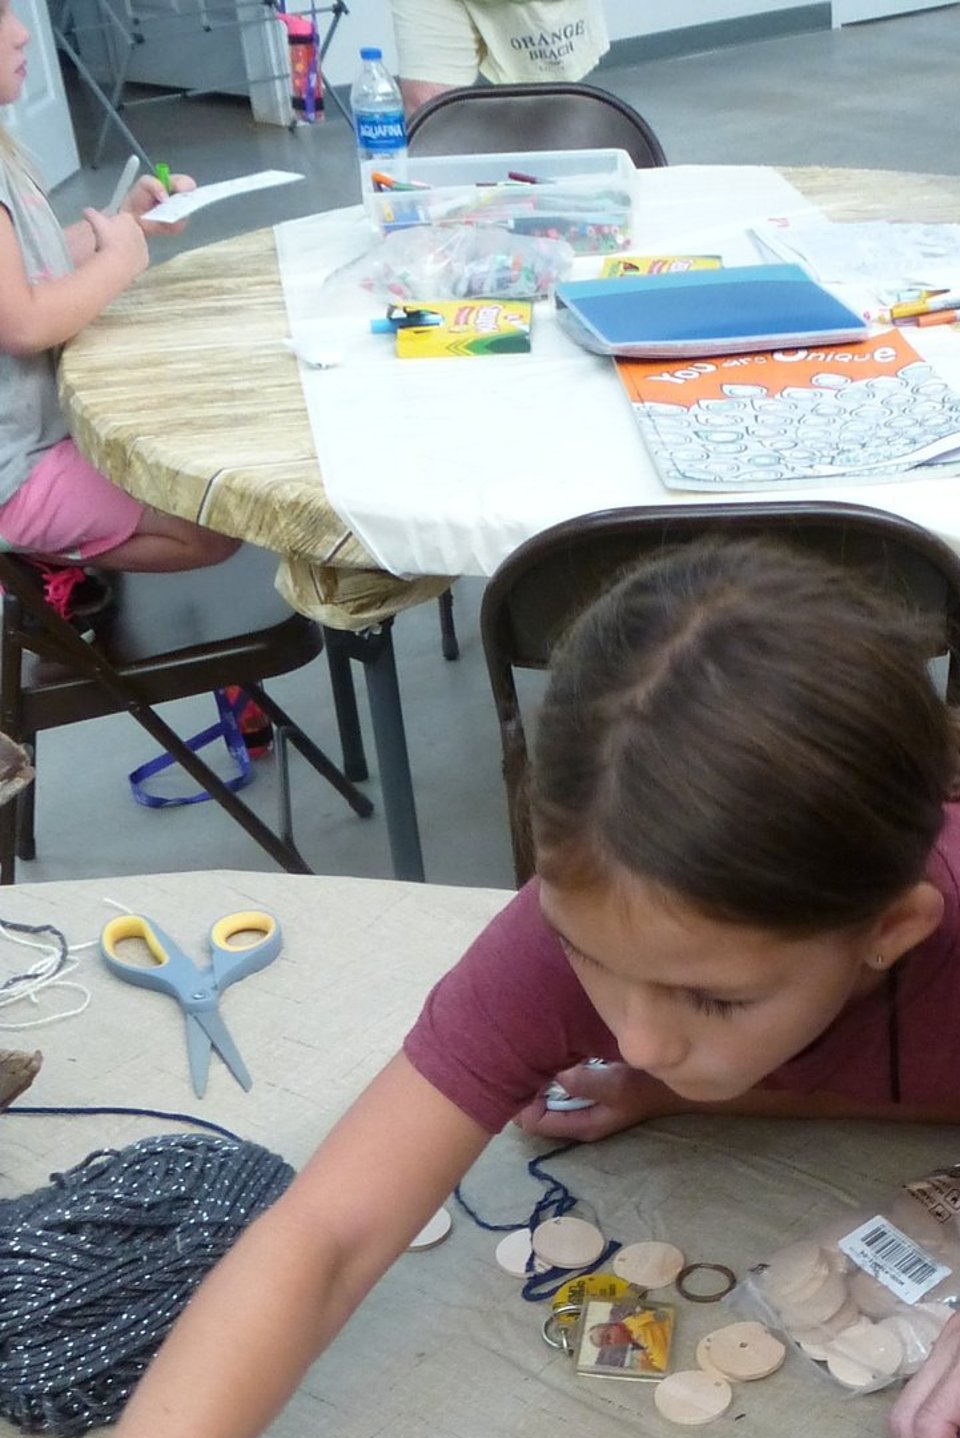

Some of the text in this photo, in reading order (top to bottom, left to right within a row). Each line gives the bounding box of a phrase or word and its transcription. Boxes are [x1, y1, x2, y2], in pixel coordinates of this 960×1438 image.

[510, 20, 585, 51] ORANGE
[529, 40, 575, 61] BEACH
[360, 123, 403, 139] AQUAFINA
